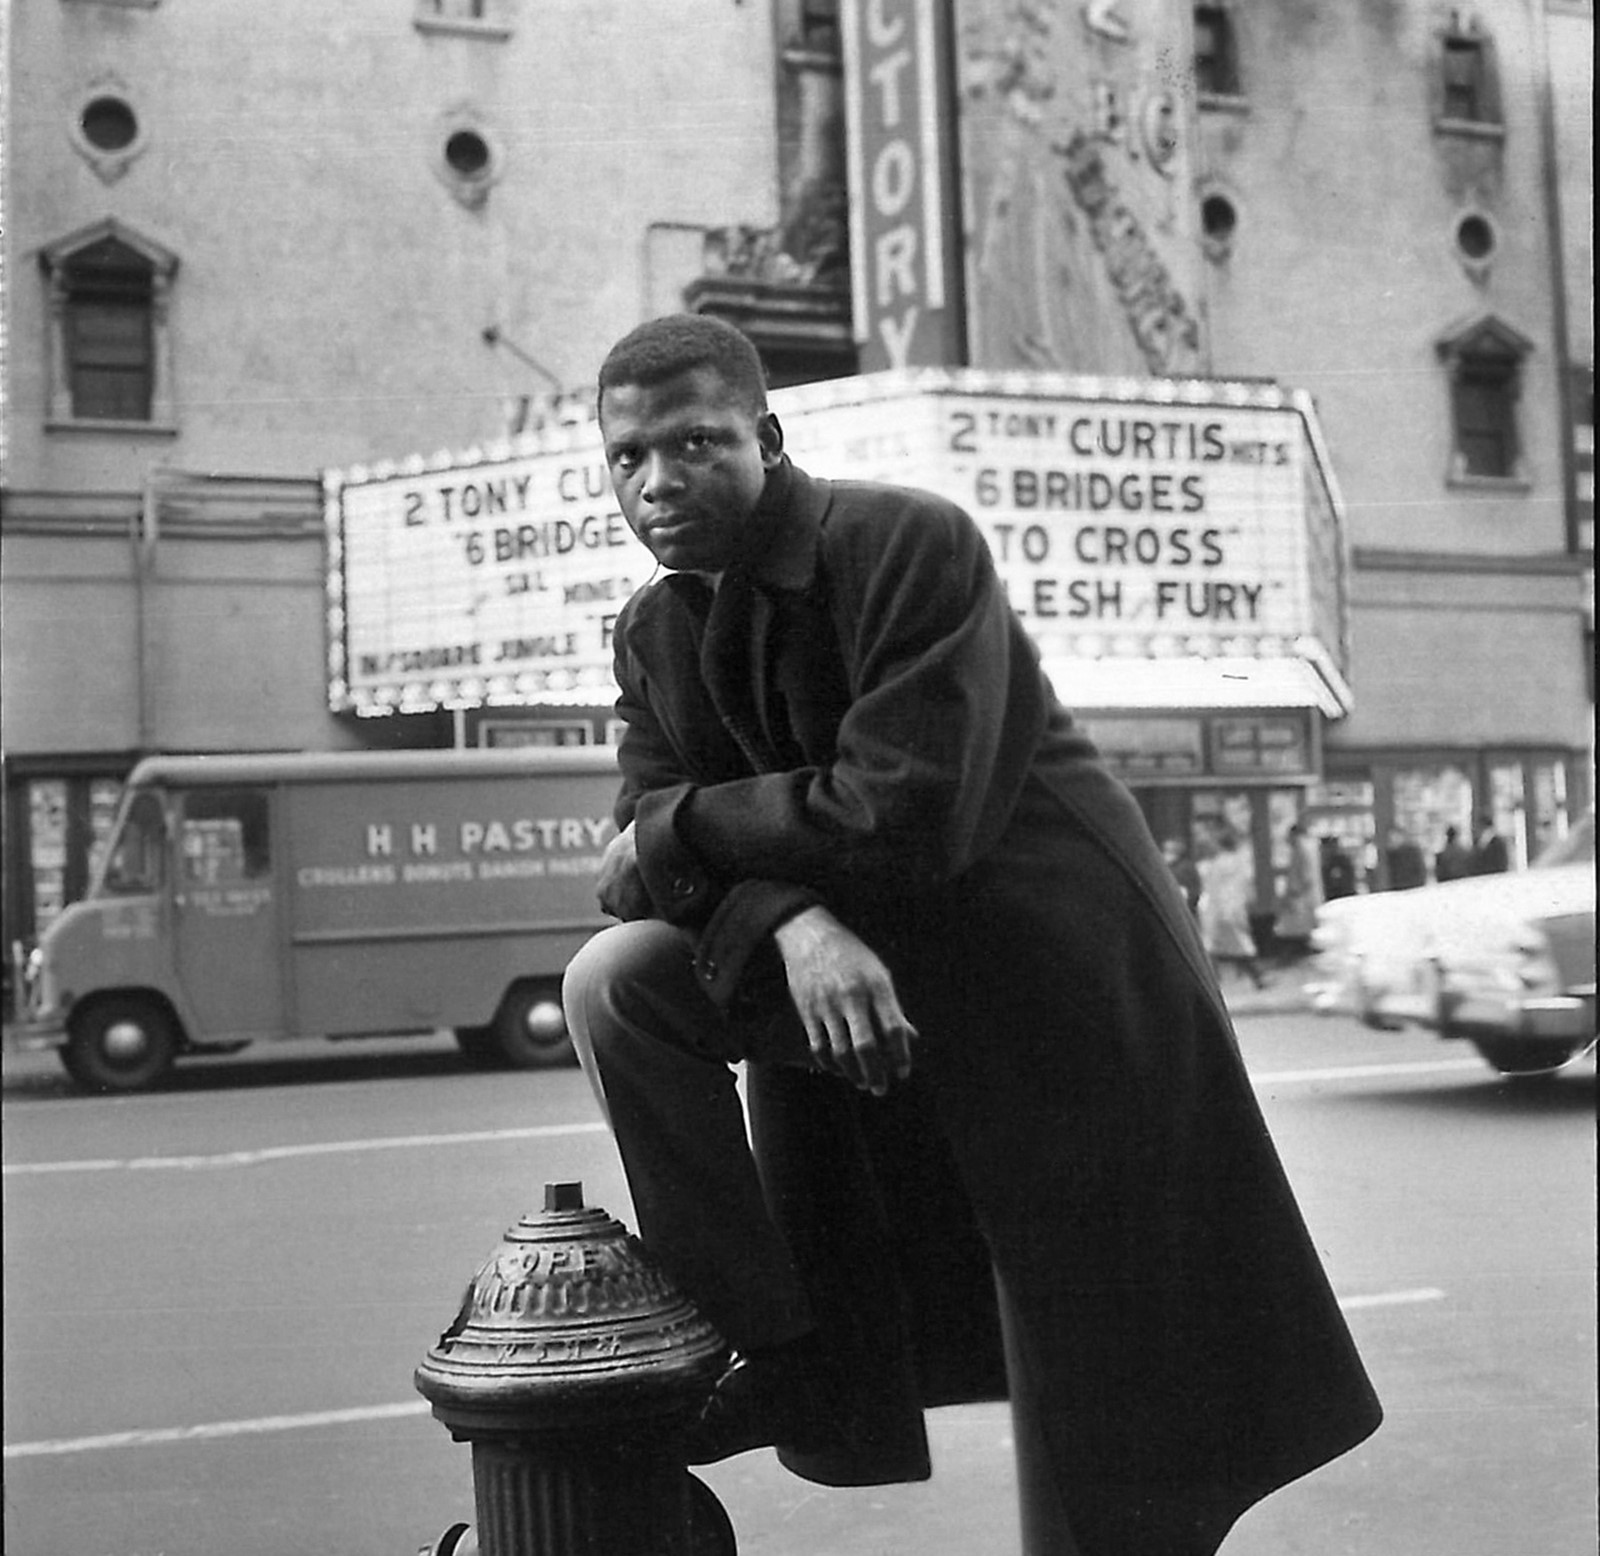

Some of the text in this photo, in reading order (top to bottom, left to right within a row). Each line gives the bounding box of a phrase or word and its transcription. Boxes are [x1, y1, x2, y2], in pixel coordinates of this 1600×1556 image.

[950, 412, 977, 452] 2
[987, 412, 1055, 438] TONY
[1070, 418, 1225, 462] CURTIS
[404, 464, 604, 526] 2 TONY CU
[1012, 470, 1204, 513] BRIDGES
[493, 511, 627, 564] BRIDGE
[993, 525, 1050, 564] TO
[366, 817, 609, 856] H H PASTRY
[403, 860, 473, 883] DONUTS
